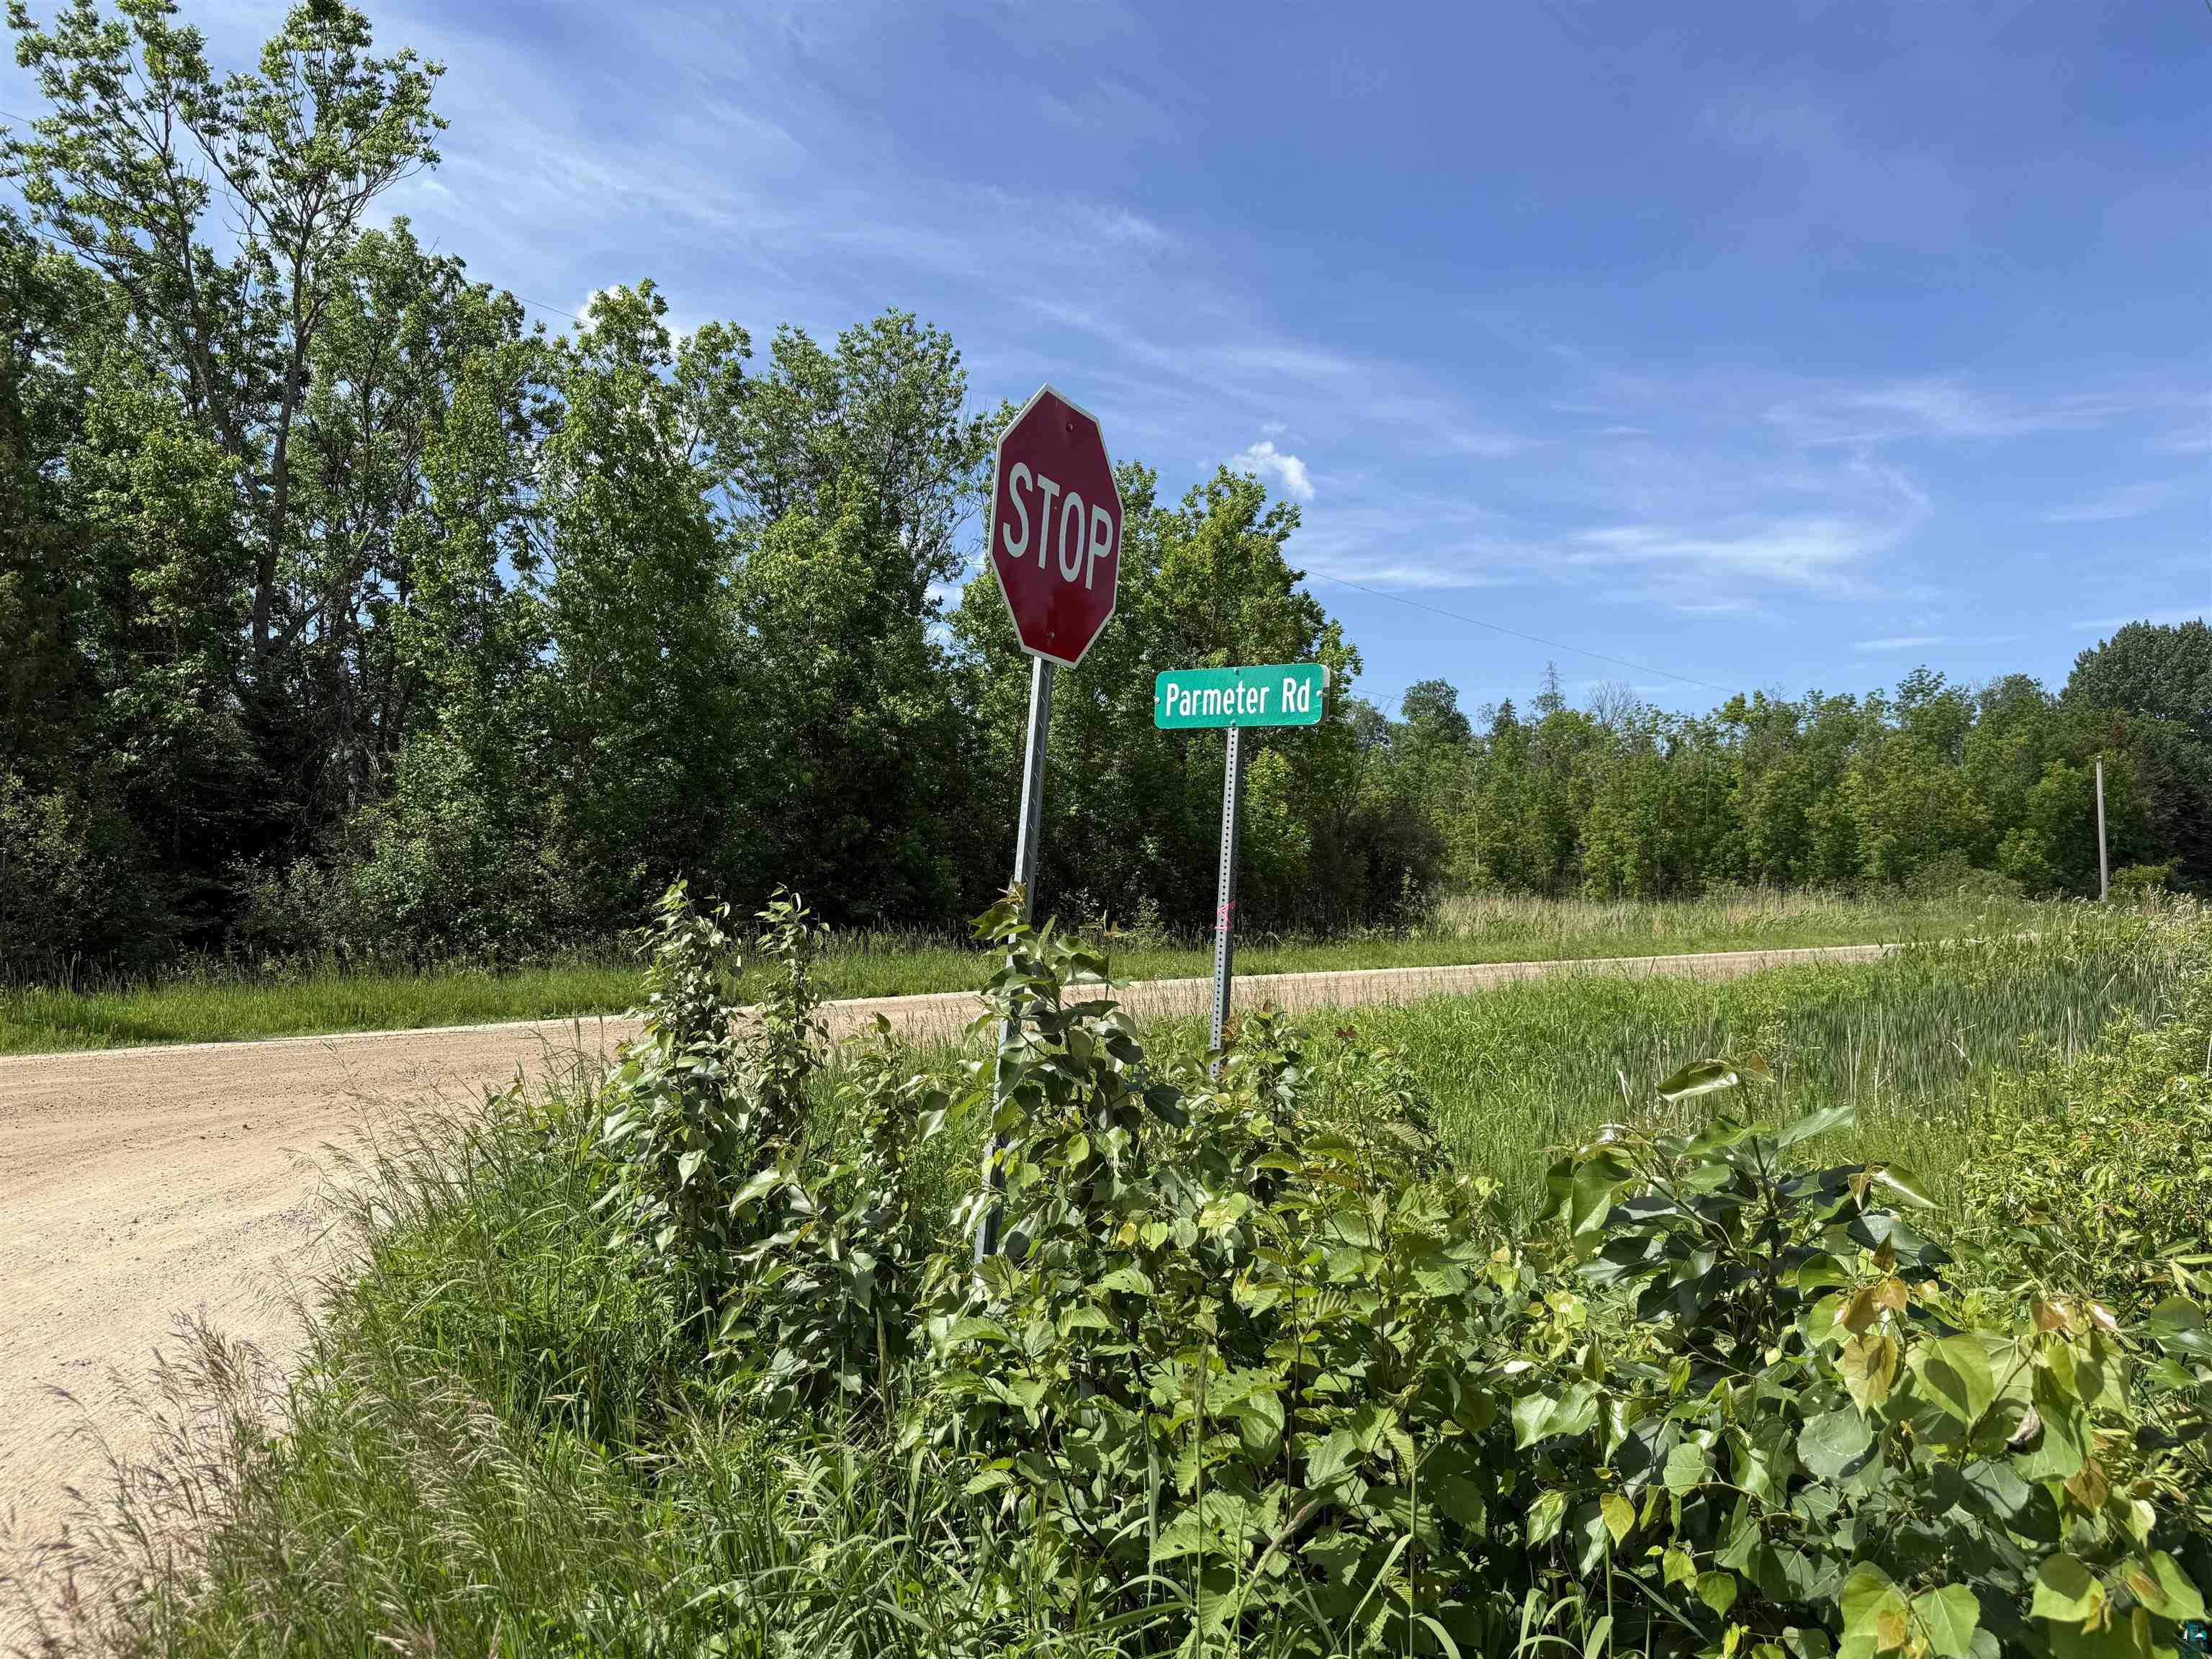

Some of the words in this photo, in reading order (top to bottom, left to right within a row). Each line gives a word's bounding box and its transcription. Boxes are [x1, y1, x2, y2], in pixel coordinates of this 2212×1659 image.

[1003, 462, 1113, 590] STOP
[1166, 680, 1270, 716] Parmeter
[1282, 677, 1310, 714] Rd
